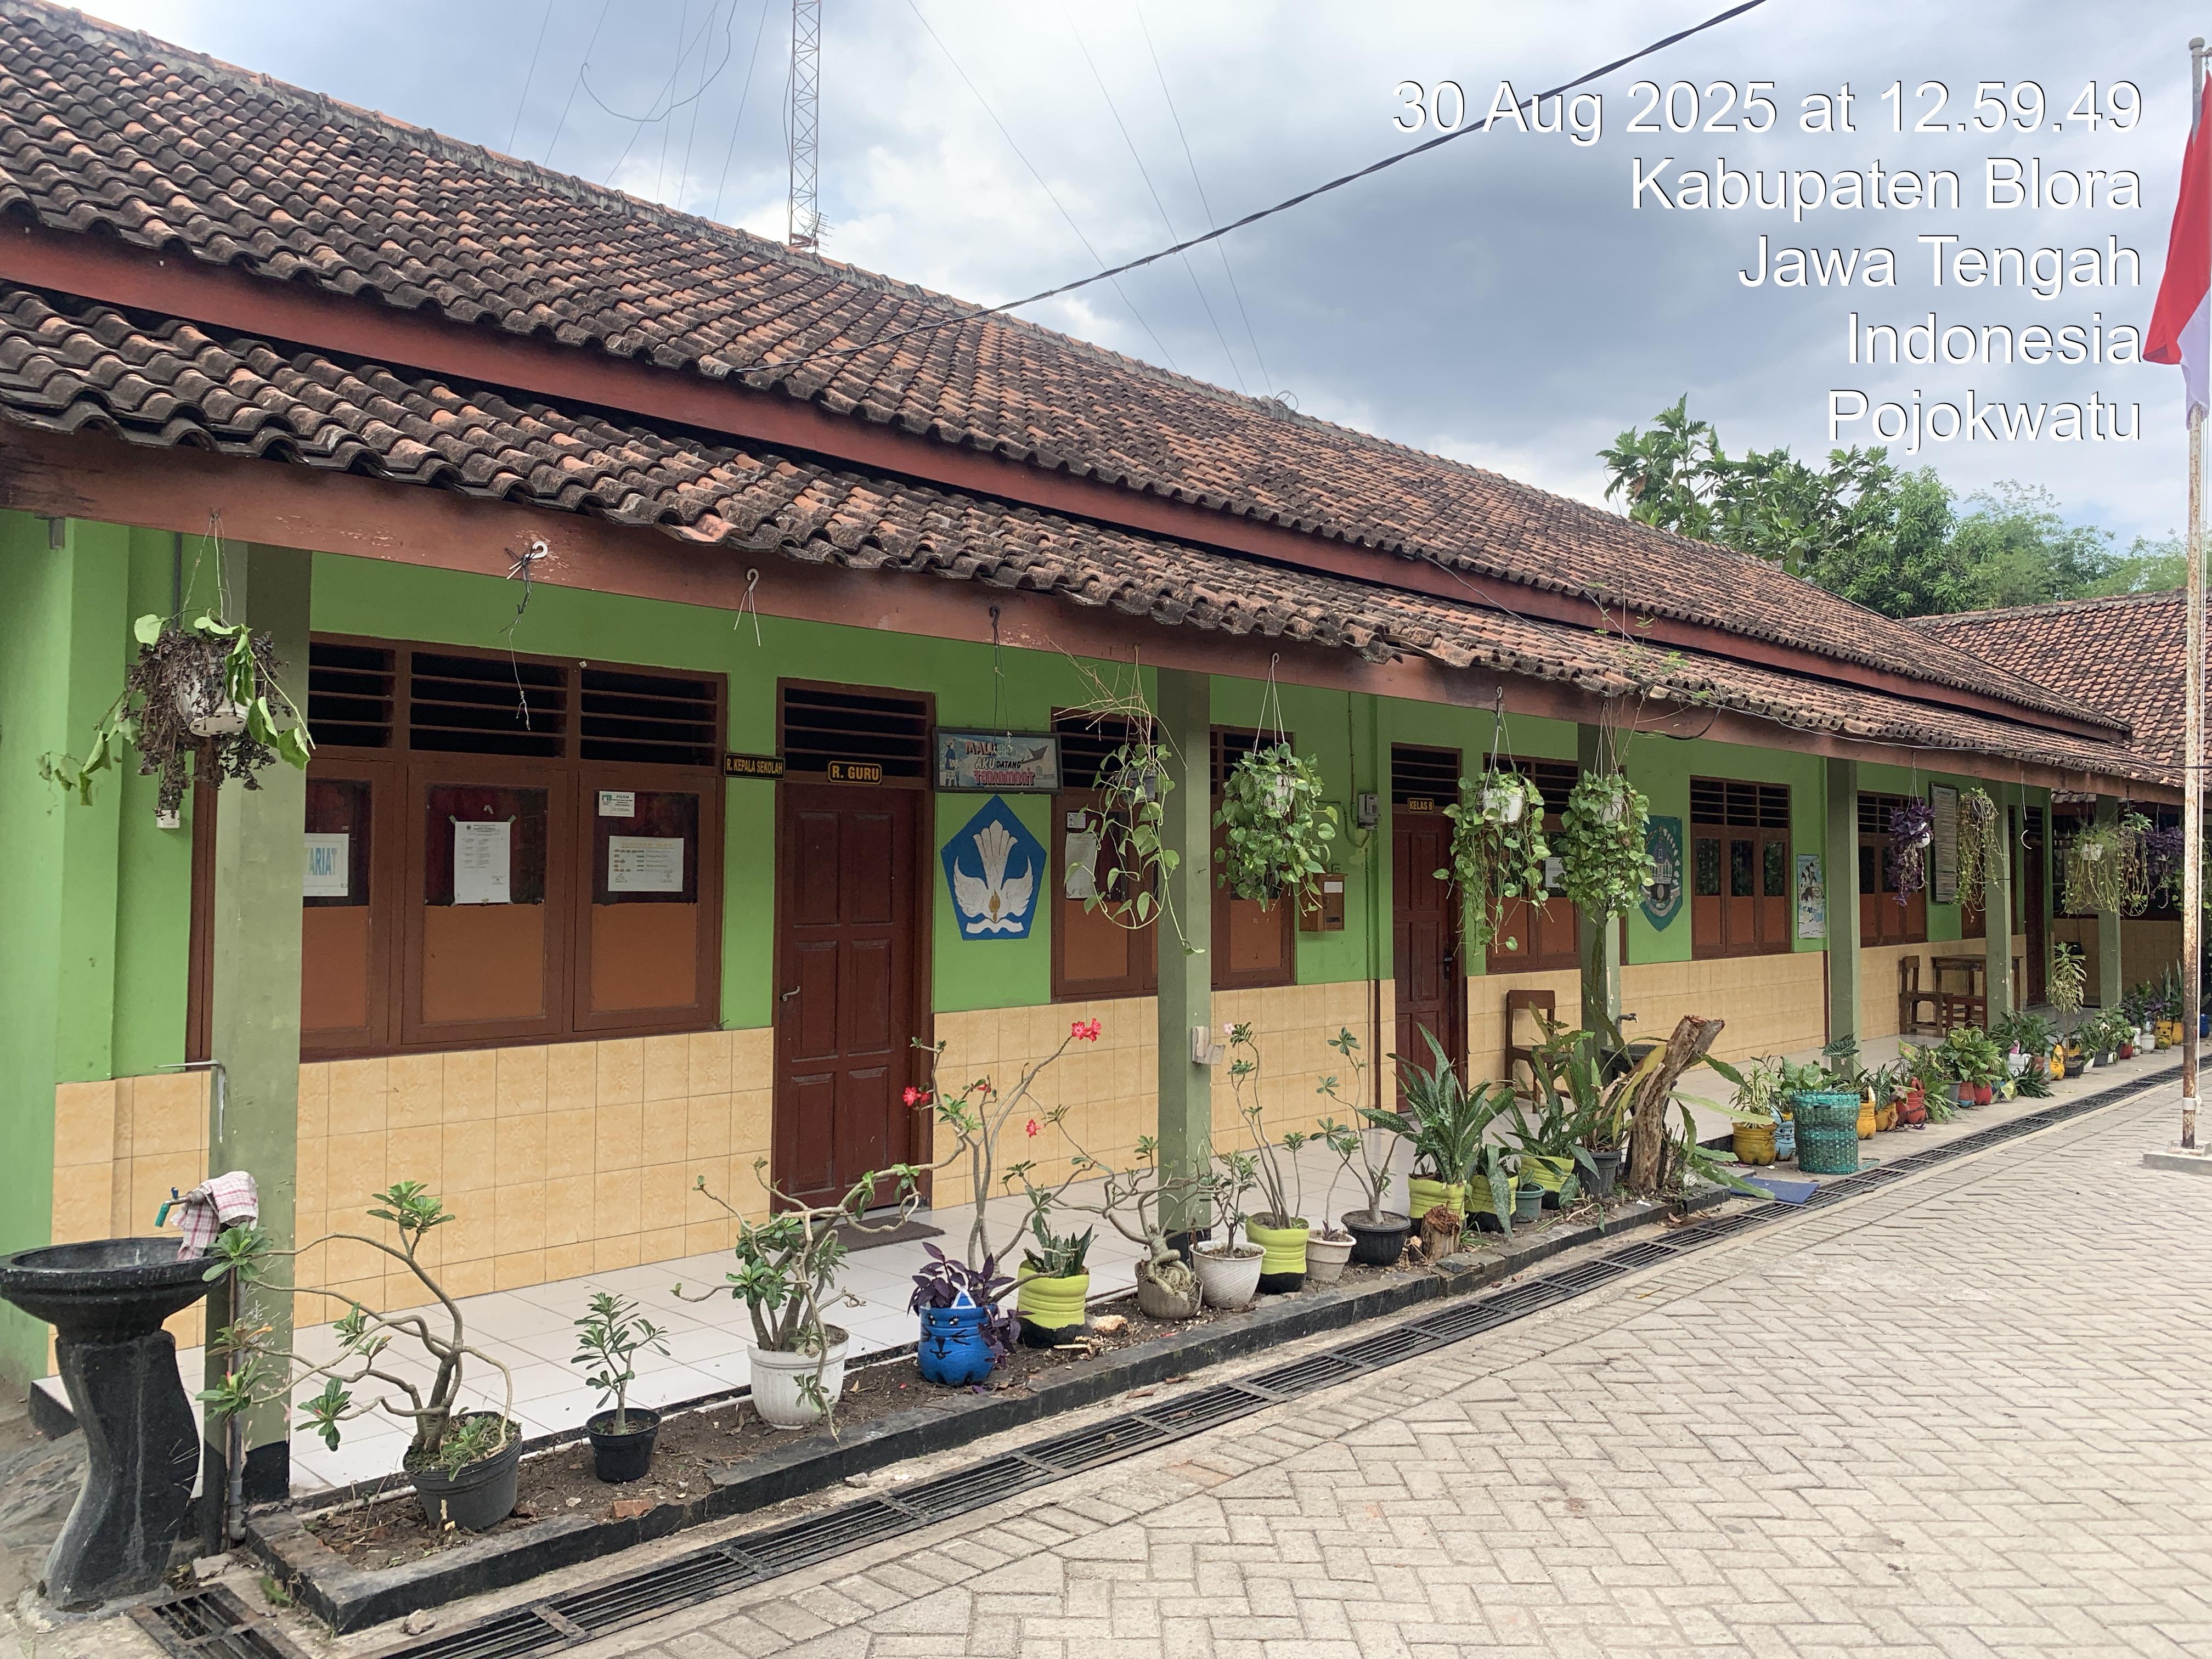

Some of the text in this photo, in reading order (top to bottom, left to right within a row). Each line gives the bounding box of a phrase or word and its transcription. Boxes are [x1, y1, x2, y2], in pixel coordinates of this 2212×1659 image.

[726, 758, 783, 774] R. KEPALA SEKOLAH
[974, 757, 1022, 769] AKU DATANG
[832, 765, 879, 781] R. GURU
[1409, 800, 1427, 810] KELAS
[304, 847, 337, 876] ARIAT
